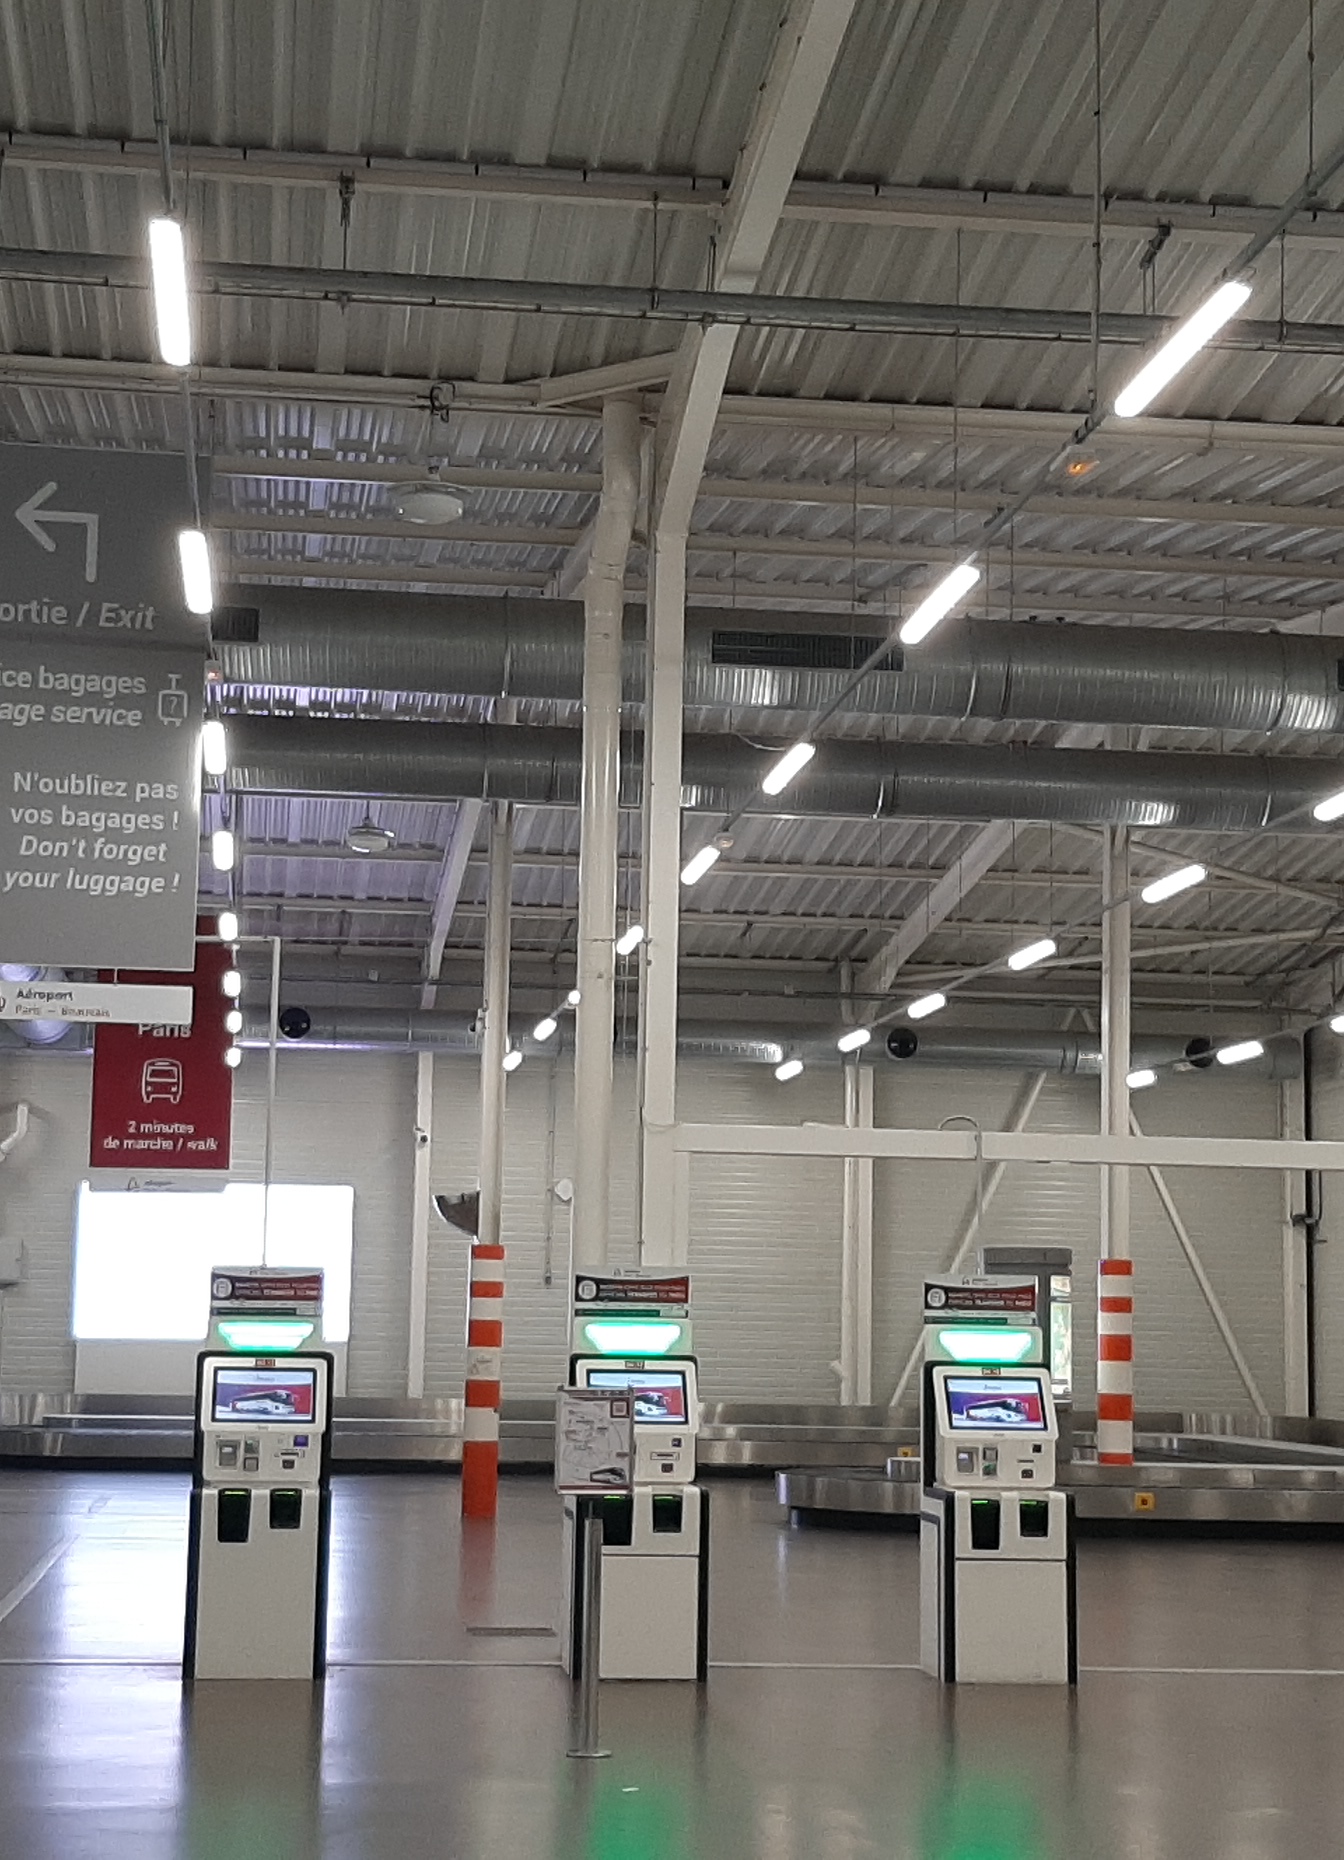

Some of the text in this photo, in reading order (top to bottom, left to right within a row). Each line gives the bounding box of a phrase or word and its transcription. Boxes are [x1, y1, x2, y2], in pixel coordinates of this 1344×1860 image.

[76, 601, 88, 628] /
[99, 603, 156, 631] Exit
[39, 666, 146, 697] bagages
[50, 700, 143, 727] service
[13, 772, 179, 803] N'oubliez pas
[10, 805, 180, 833] vos bagages !
[19, 835, 168, 865] Don't forget
[2, 869, 180, 897] your luggage !
[16, 988, 73, 1002] Aéroport
[127, 1119, 195, 1133] 2 minutes
[103, 1136, 119, 1149] de
